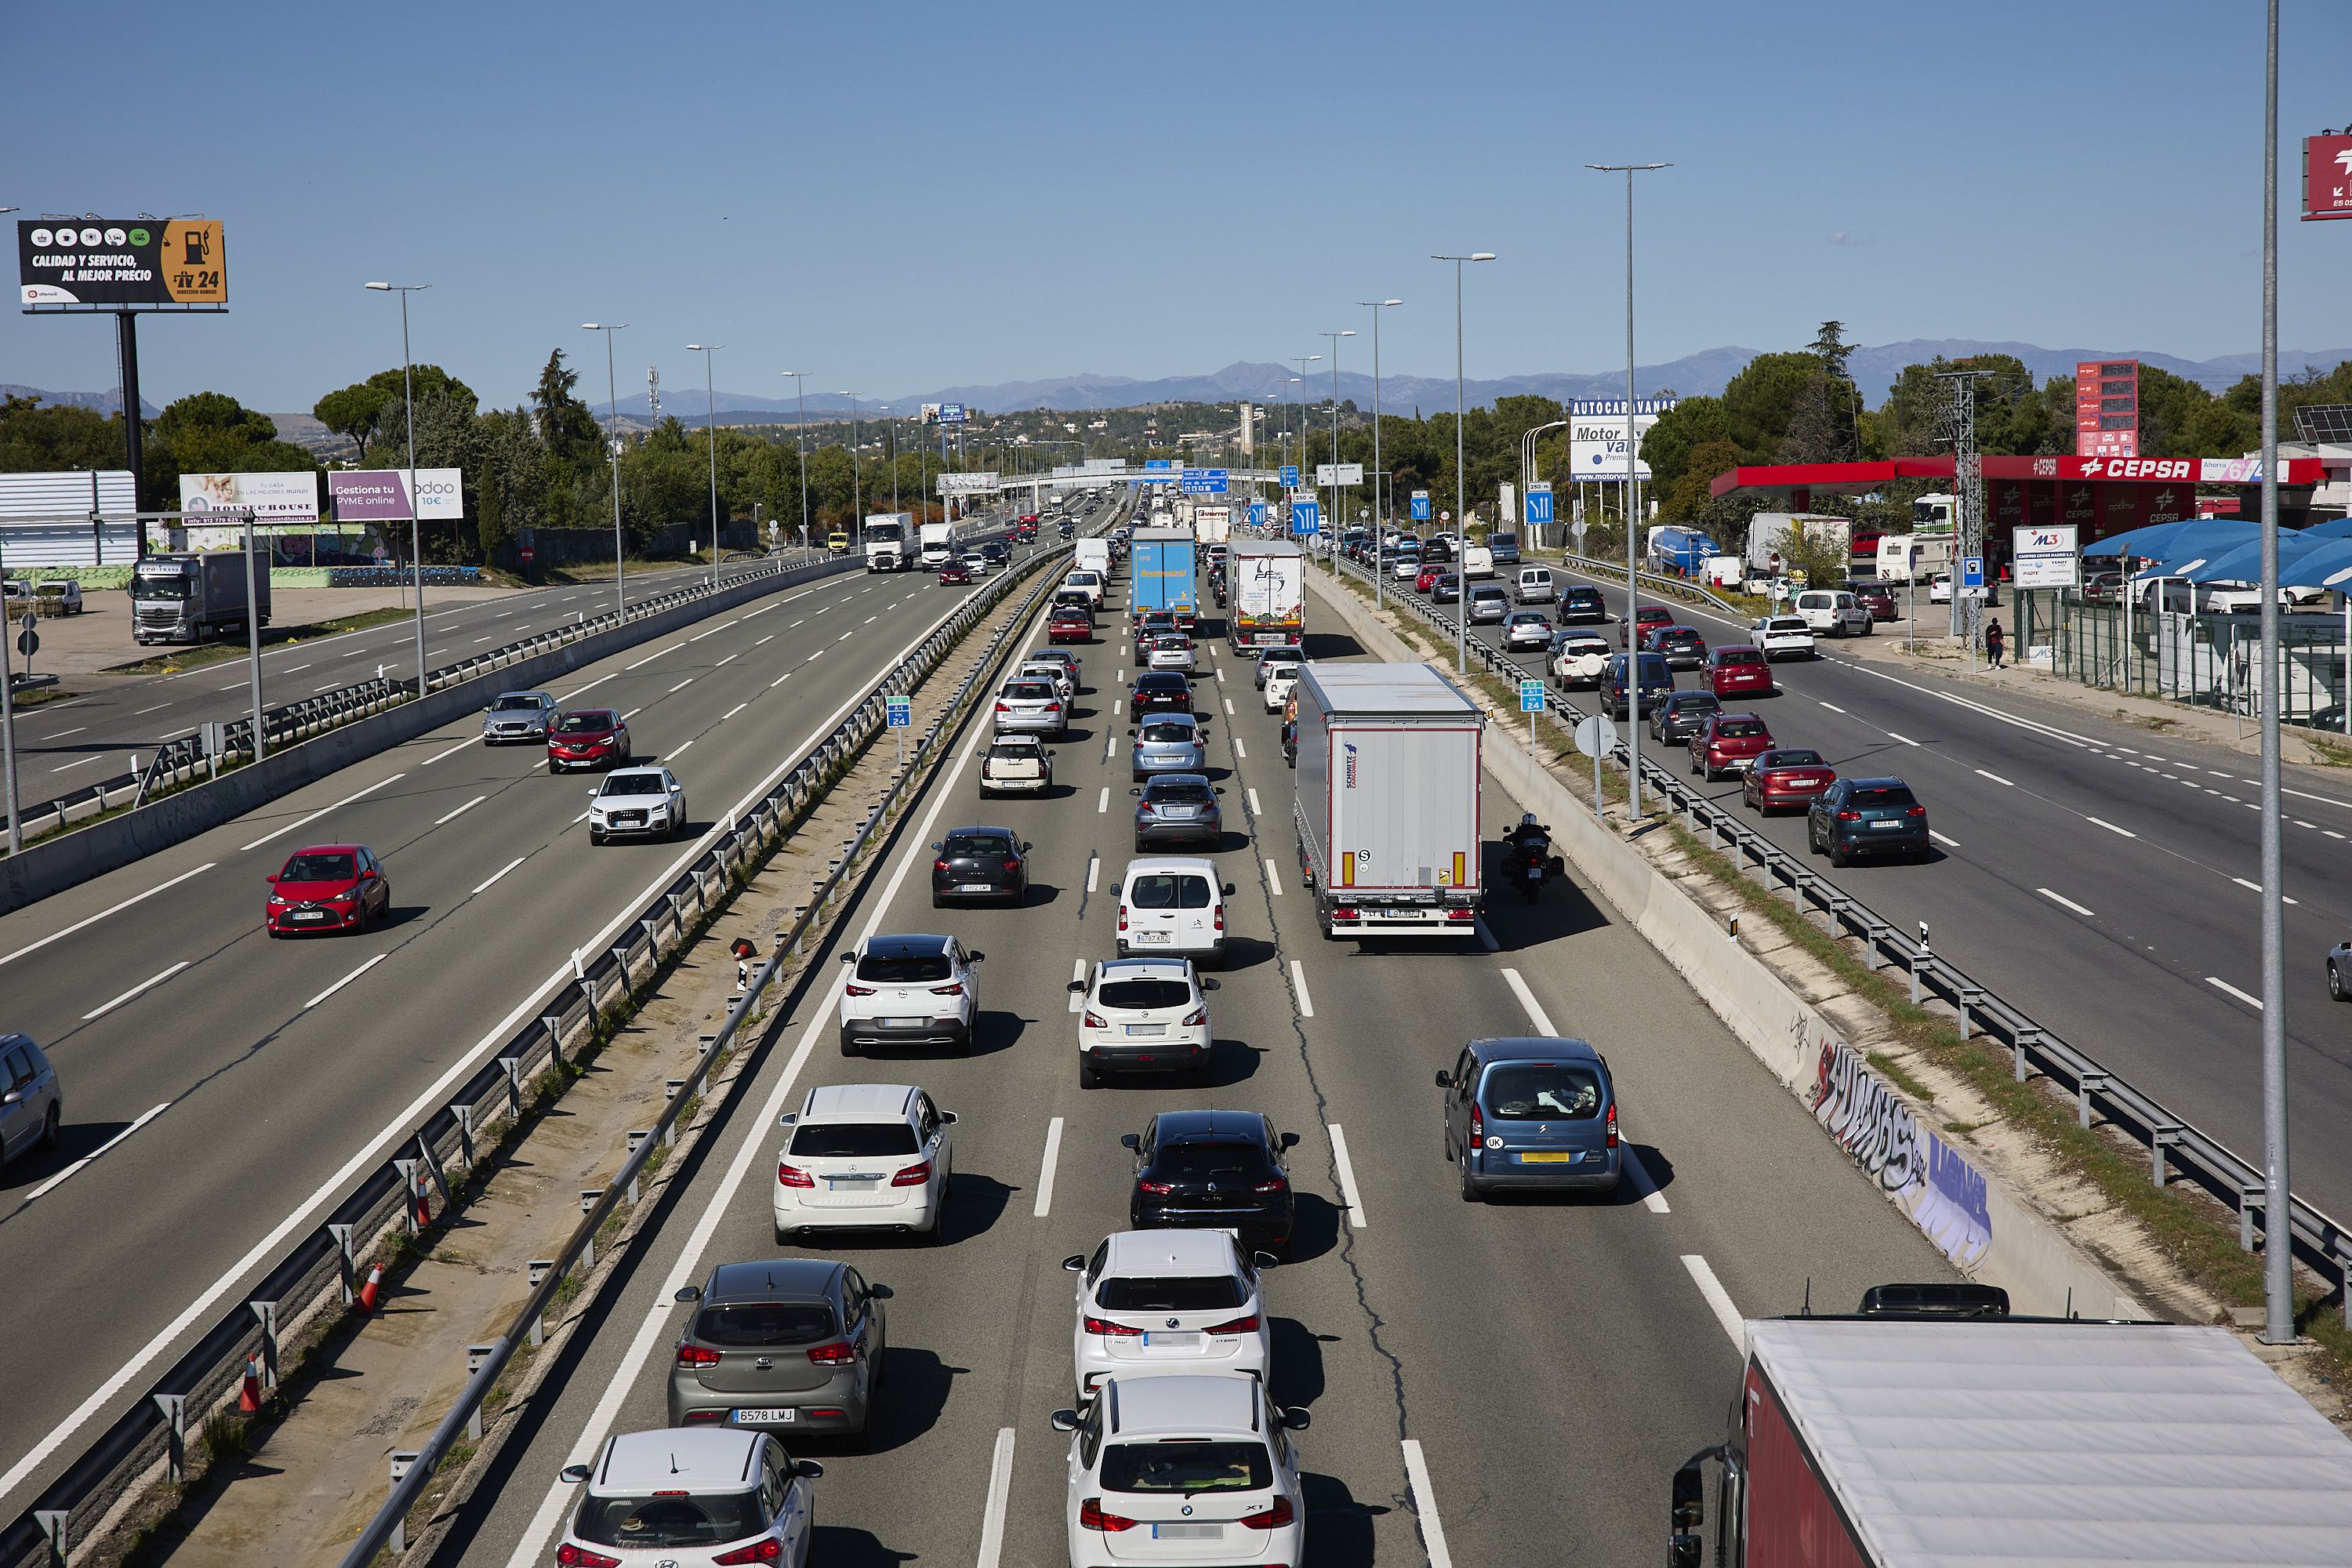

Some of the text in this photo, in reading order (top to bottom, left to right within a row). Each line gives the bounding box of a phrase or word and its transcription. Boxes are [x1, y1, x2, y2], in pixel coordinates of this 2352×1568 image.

[32, 255, 137, 269] CALIDAD Y SERVICIO,
[61, 270, 152, 281] AL MEJOR PRECIO
[198, 271, 219, 289] 24
[1573, 400, 1676, 415] AUTOCARVANAS
[1577, 427, 1621, 440] Motor
[2039, 459, 2056, 475] CEPSA
[2107, 460, 2190, 478] CEPSA
[336, 486, 381, 495] Gestiona
[415, 481, 454, 494] odoo
[2067, 510, 2094, 518] CEPSA
[2150, 513, 2179, 522] CEPSA
[1360, 851, 1369, 861] S
[741, 1410, 792, 1421] 6578 LMJ
